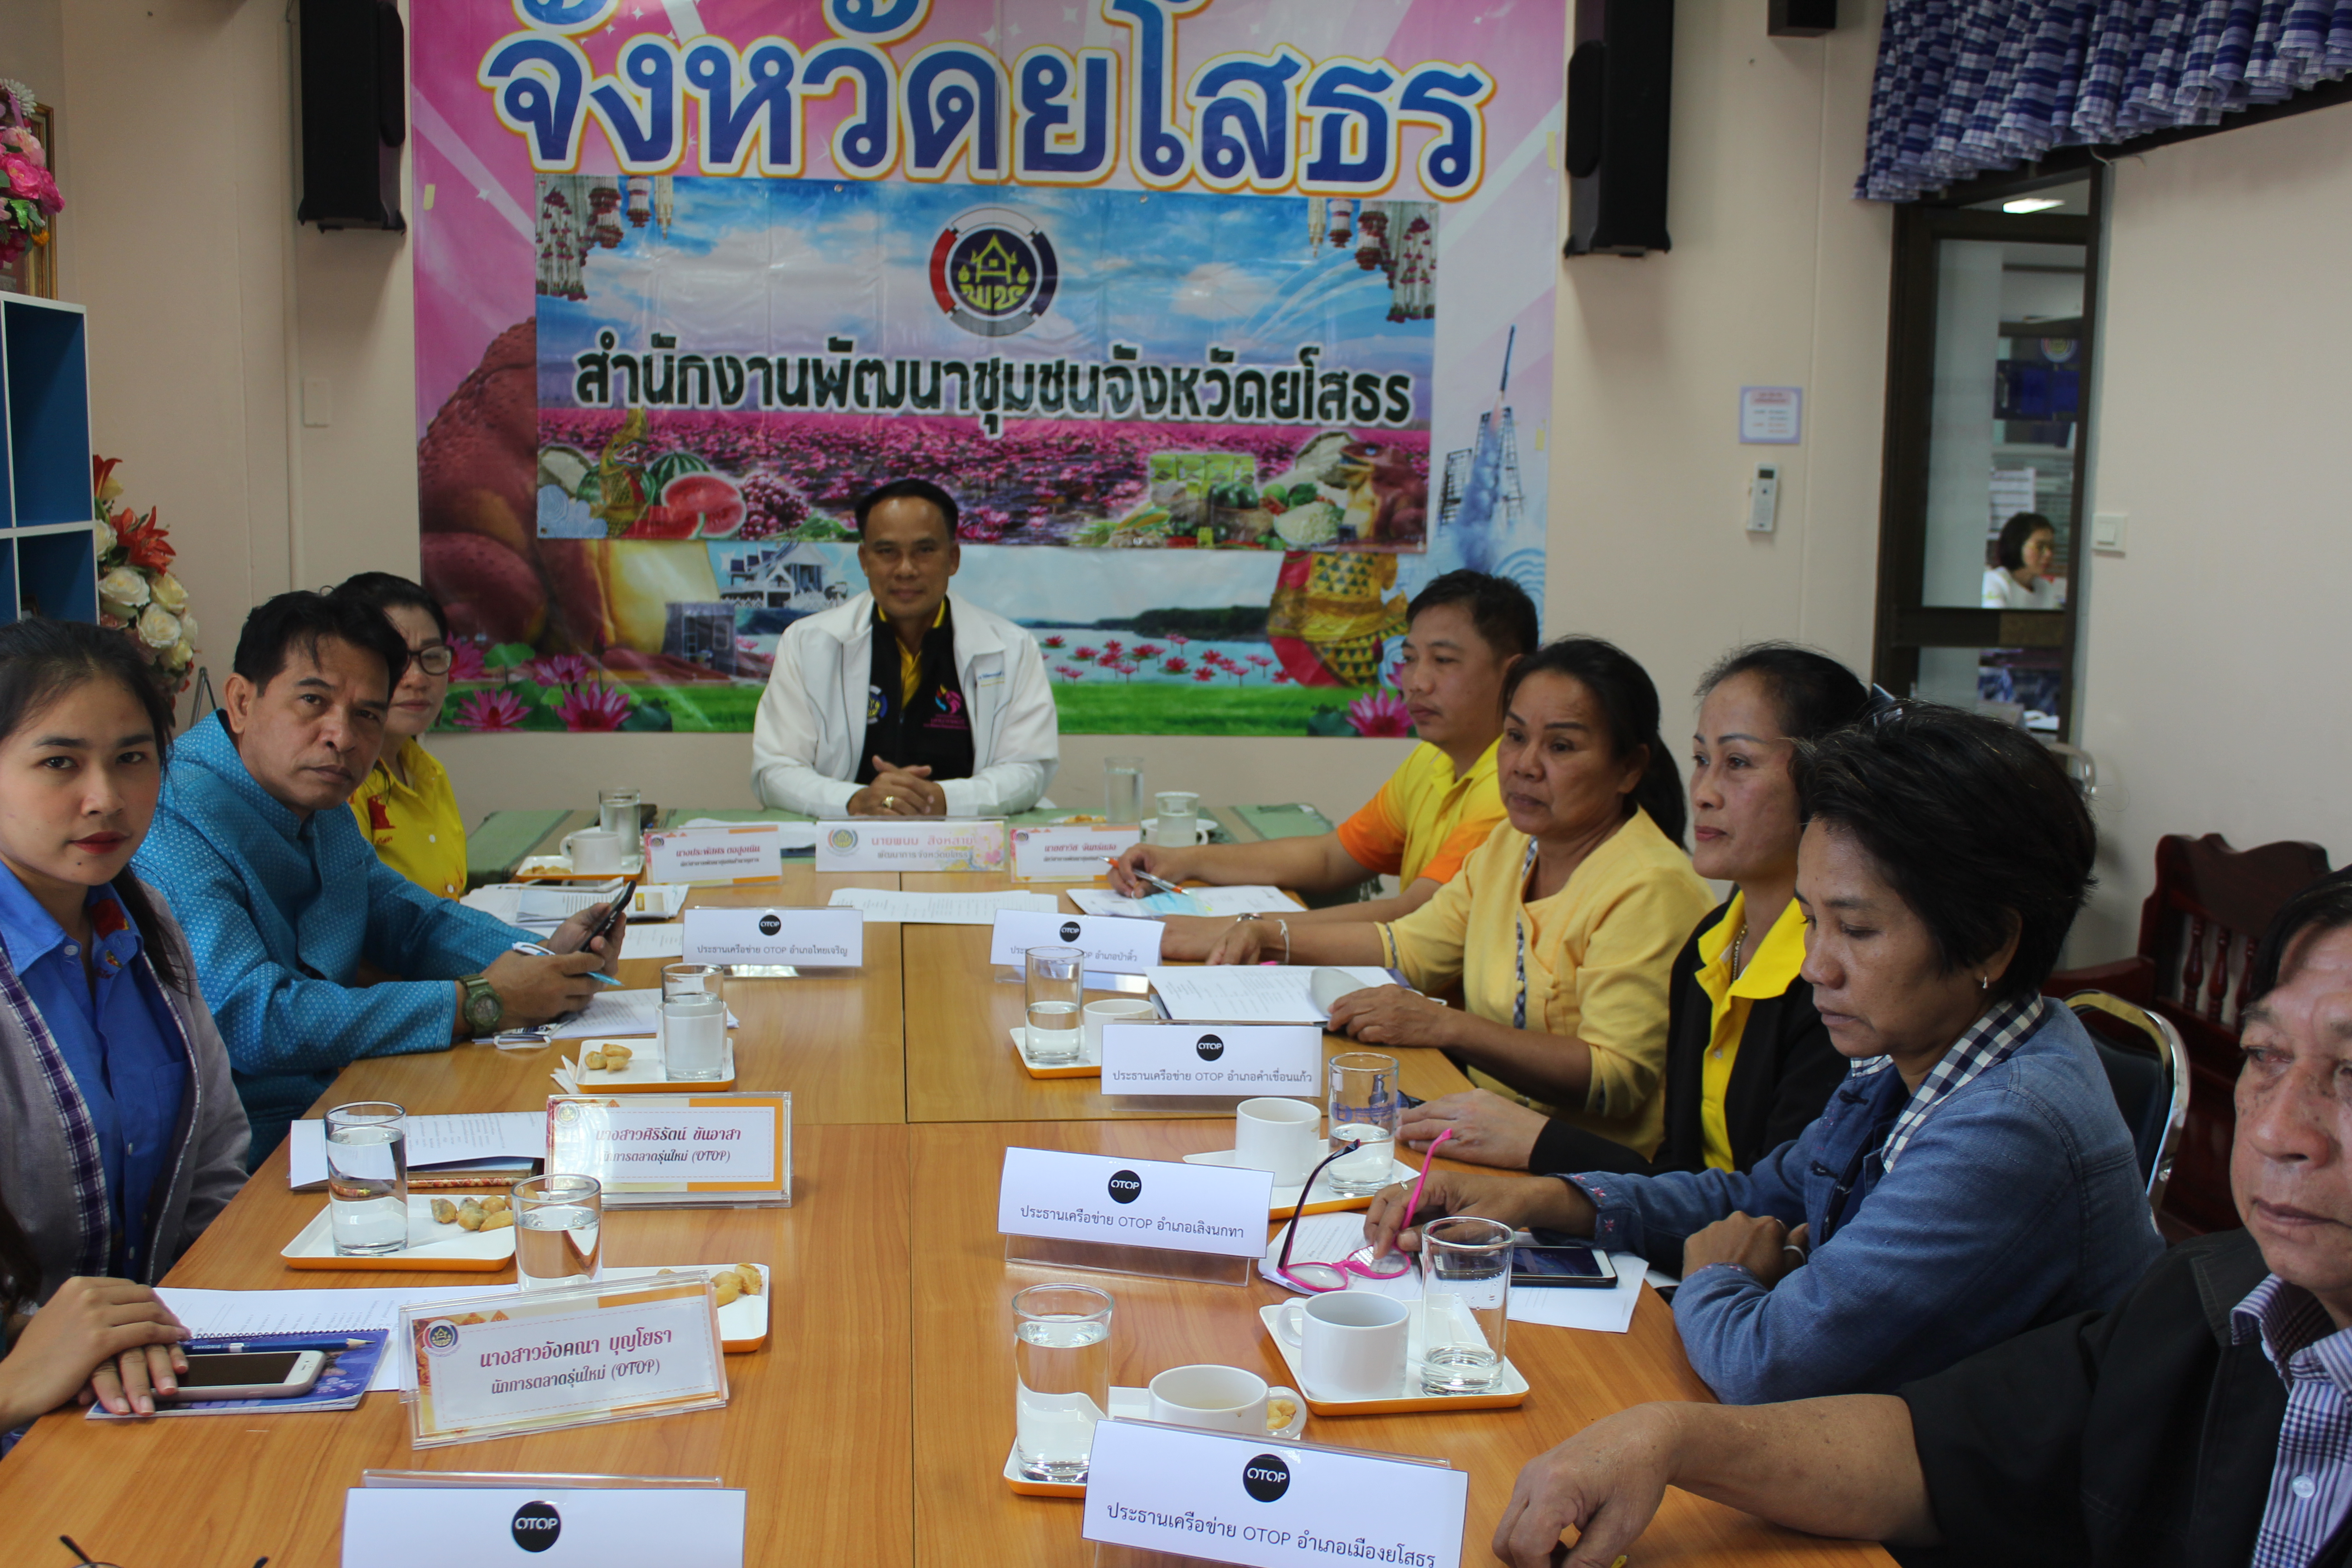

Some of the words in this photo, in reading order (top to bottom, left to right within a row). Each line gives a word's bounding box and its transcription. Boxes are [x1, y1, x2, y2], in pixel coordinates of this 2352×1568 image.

[575, 331, 1412, 436] สำนักงานพัฒนาชุมชนจังหวัดยโสธร
[697, 944, 761, 954] ประธานเครือข่าย
[789, 944, 848, 957] อำเภอไทยเจริญ
[1112, 1069, 1191, 1082] ประธานเครือข่าย
[1195, 1072, 1224, 1082] OTOP
[1227, 1068, 1312, 1082] อำเภอคำเขื่อนแก้ว
[691, 1150, 731, 1163] (OTOP)
[1110, 1179, 1140, 1190] OTOP
[1020, 1205, 1114, 1226] ประธานเครือข่าย
[1118, 1216, 1152, 1229] OTOP
[1157, 1218, 1245, 1239] อำเภอเลิงนกทา
[480, 1339, 600, 1368] นางสาวอังคณา
[608, 1327, 672, 1356] บุญโยธา
[491, 1364, 606, 1395] นักการตลาดรุ่นใหม่
[611, 1357, 661, 1382] (OTOP)
[1246, 1467, 1287, 1483] OTOP
[515, 1517, 558, 1530] OTOP
[1107, 1502, 1236, 1538] ประธานเครือข่าย
[1243, 1526, 1291, 1545] OTOP
[1297, 1529, 1436, 1568] อำเภอเมืองยโสธร
